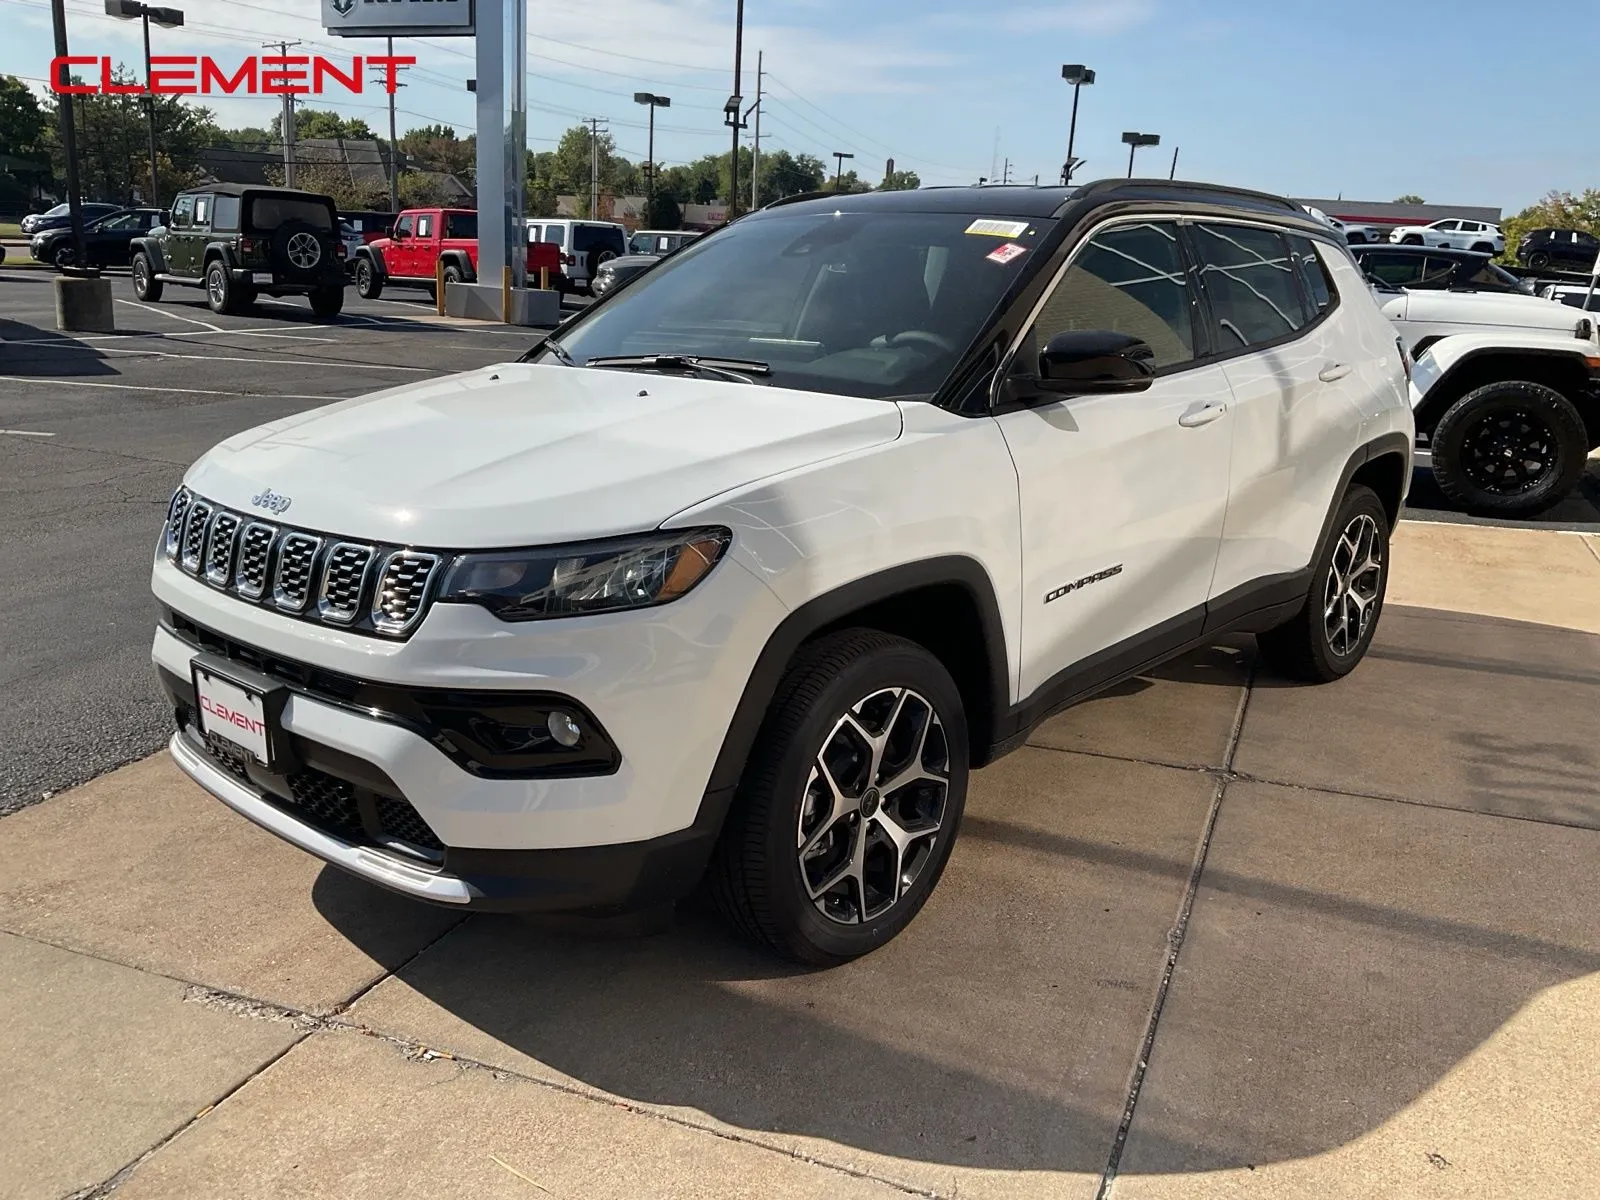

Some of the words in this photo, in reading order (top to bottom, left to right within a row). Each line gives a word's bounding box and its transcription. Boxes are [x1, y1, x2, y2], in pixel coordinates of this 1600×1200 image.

[251, 487, 292, 515] Jeep
[1044, 563, 1123, 604] COMPASS
[200, 695, 267, 737] CLEMENT
